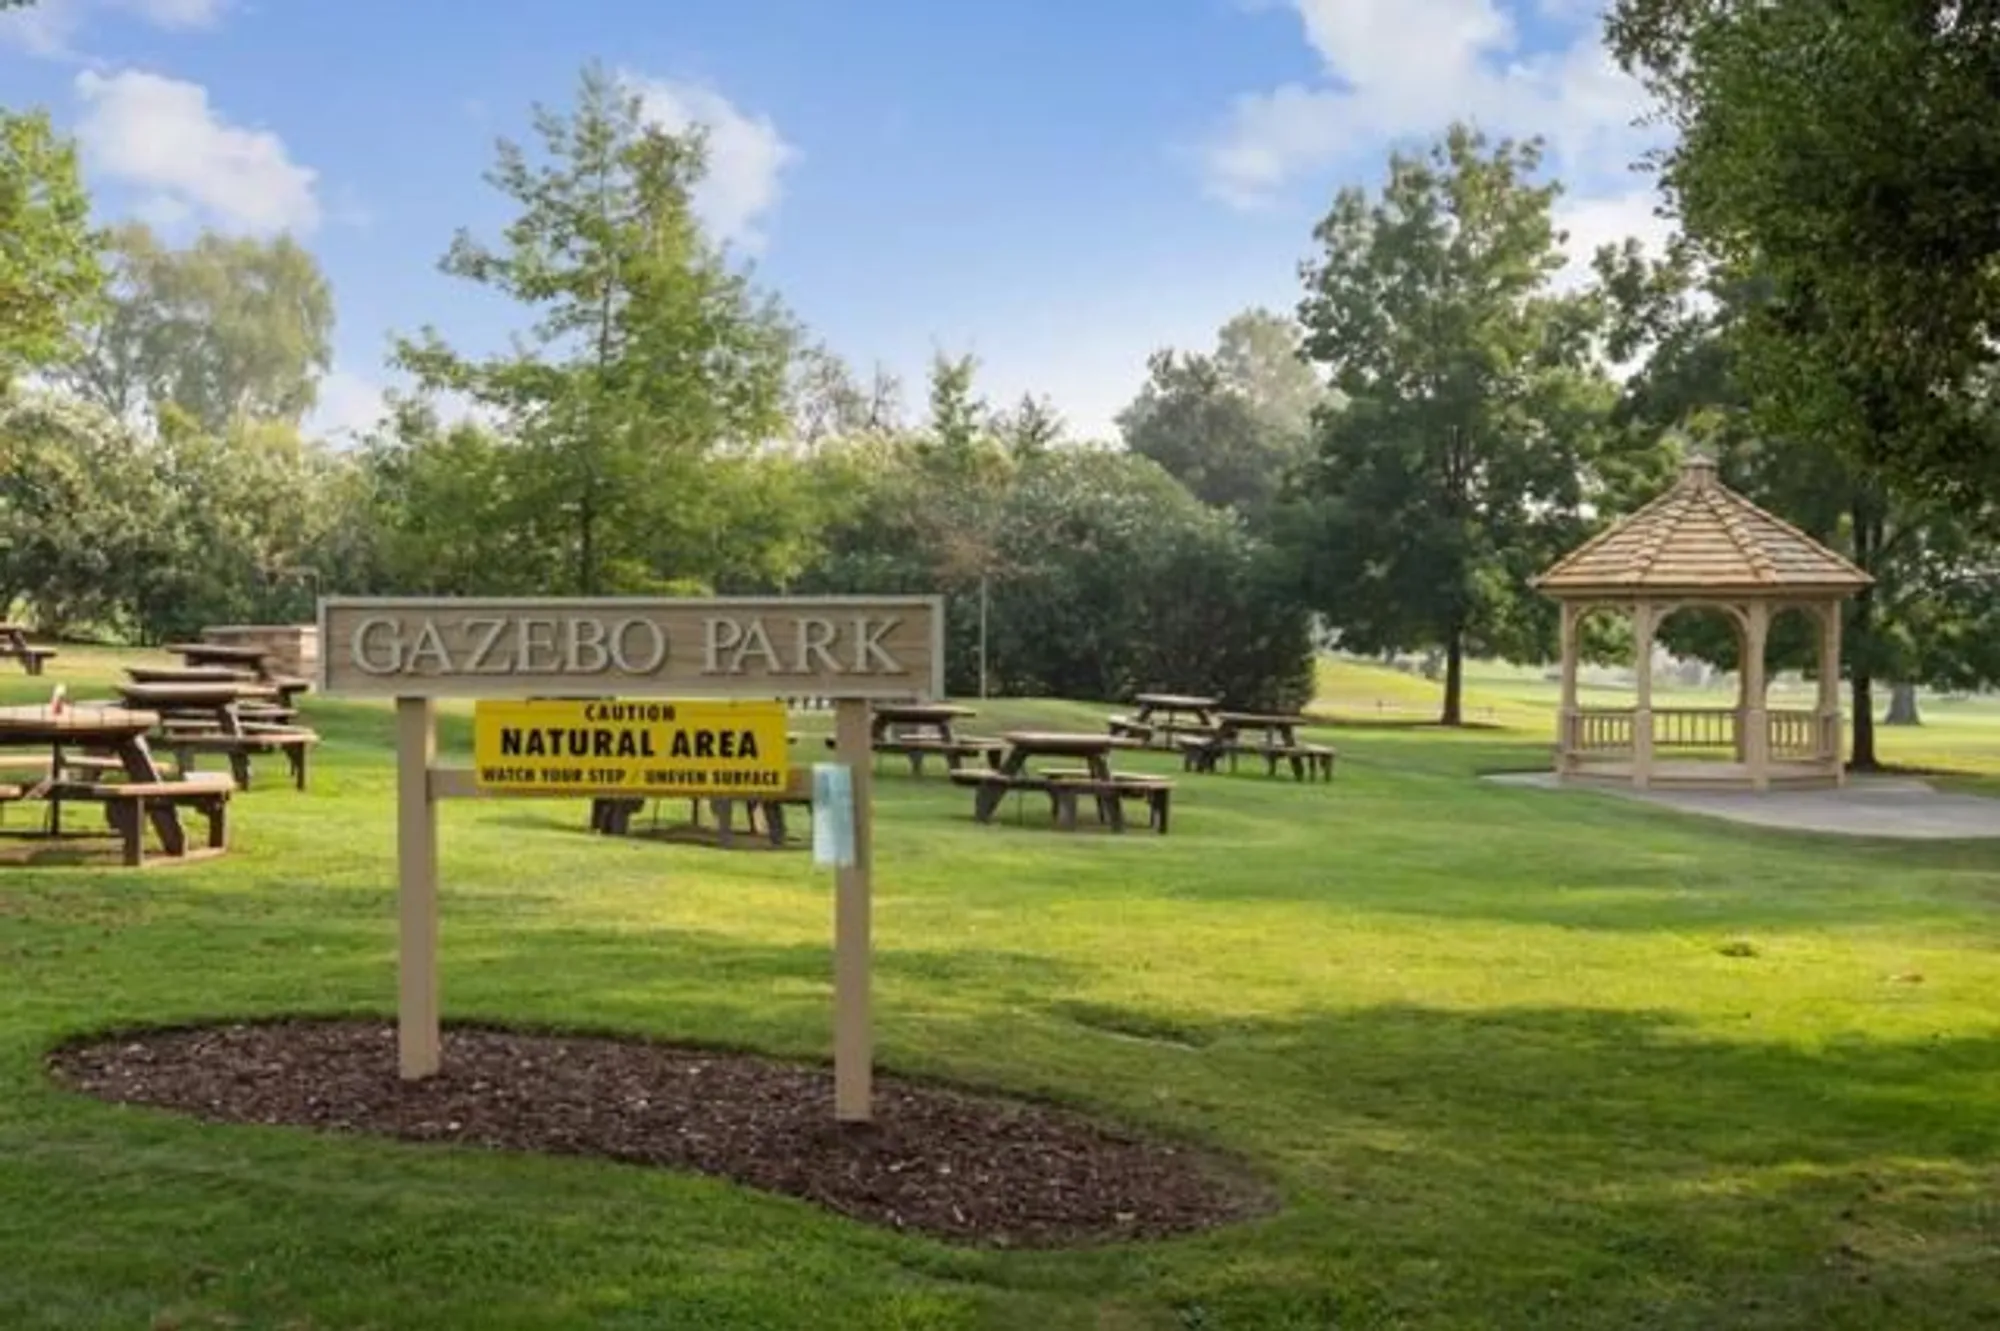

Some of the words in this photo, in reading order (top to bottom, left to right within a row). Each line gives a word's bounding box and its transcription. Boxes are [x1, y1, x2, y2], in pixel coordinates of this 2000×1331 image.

[352, 615, 668, 675] GAZEBO
[702, 616, 906, 674] PARK
[585, 704, 676, 722] CAUTION
[501, 728, 655, 757] NATURAL
[671, 728, 758, 758] AREA
[482, 766, 536, 782] WATCH
[541, 767, 582, 783] YOUR
[588, 768, 627, 783] STEP
[644, 769, 707, 785] UNEVEN
[712, 770, 779, 785] SURFACE
